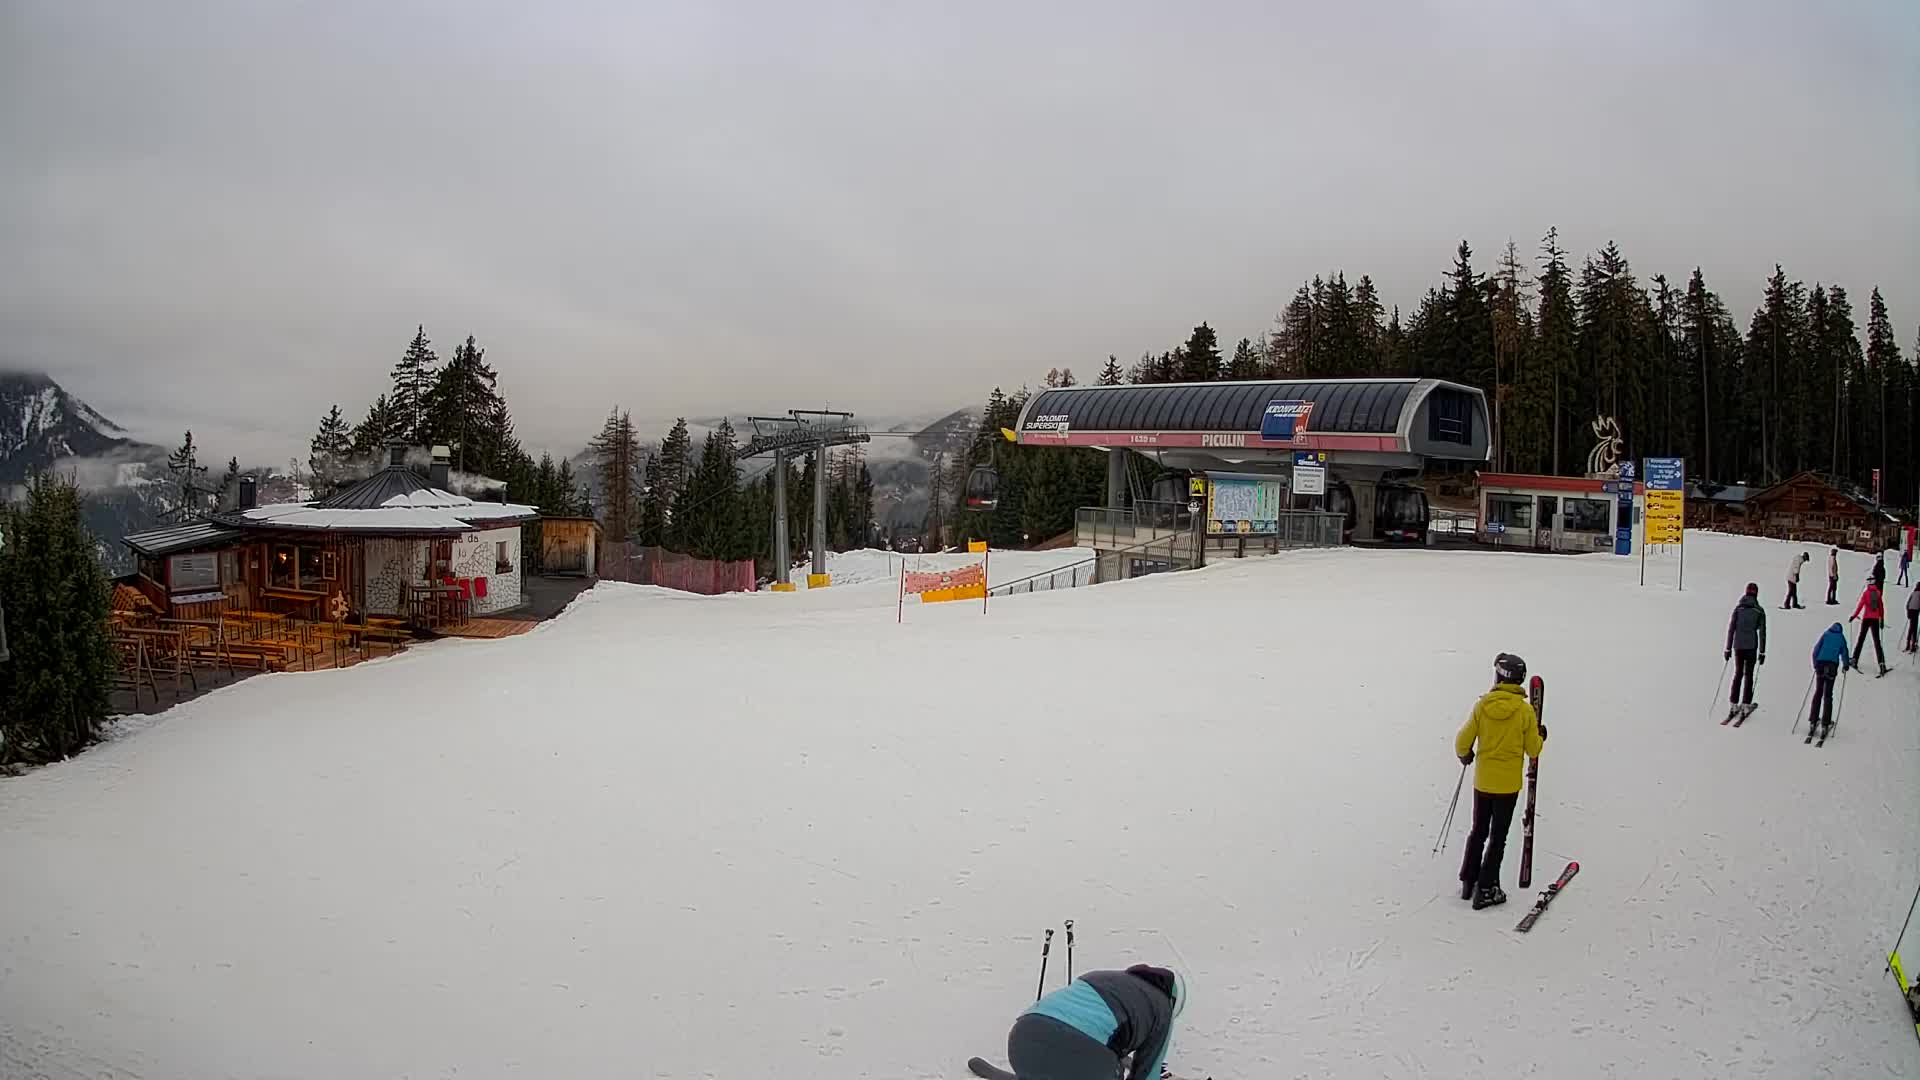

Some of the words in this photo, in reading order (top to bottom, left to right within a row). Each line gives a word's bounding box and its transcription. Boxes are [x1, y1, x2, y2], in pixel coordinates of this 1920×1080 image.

[1266, 405, 1311, 413] KRONPLATZ
[1026, 422, 1059, 430] SUPERSKI
[1202, 434, 1245, 447] PICULIN
[468, 534, 479, 543] da
